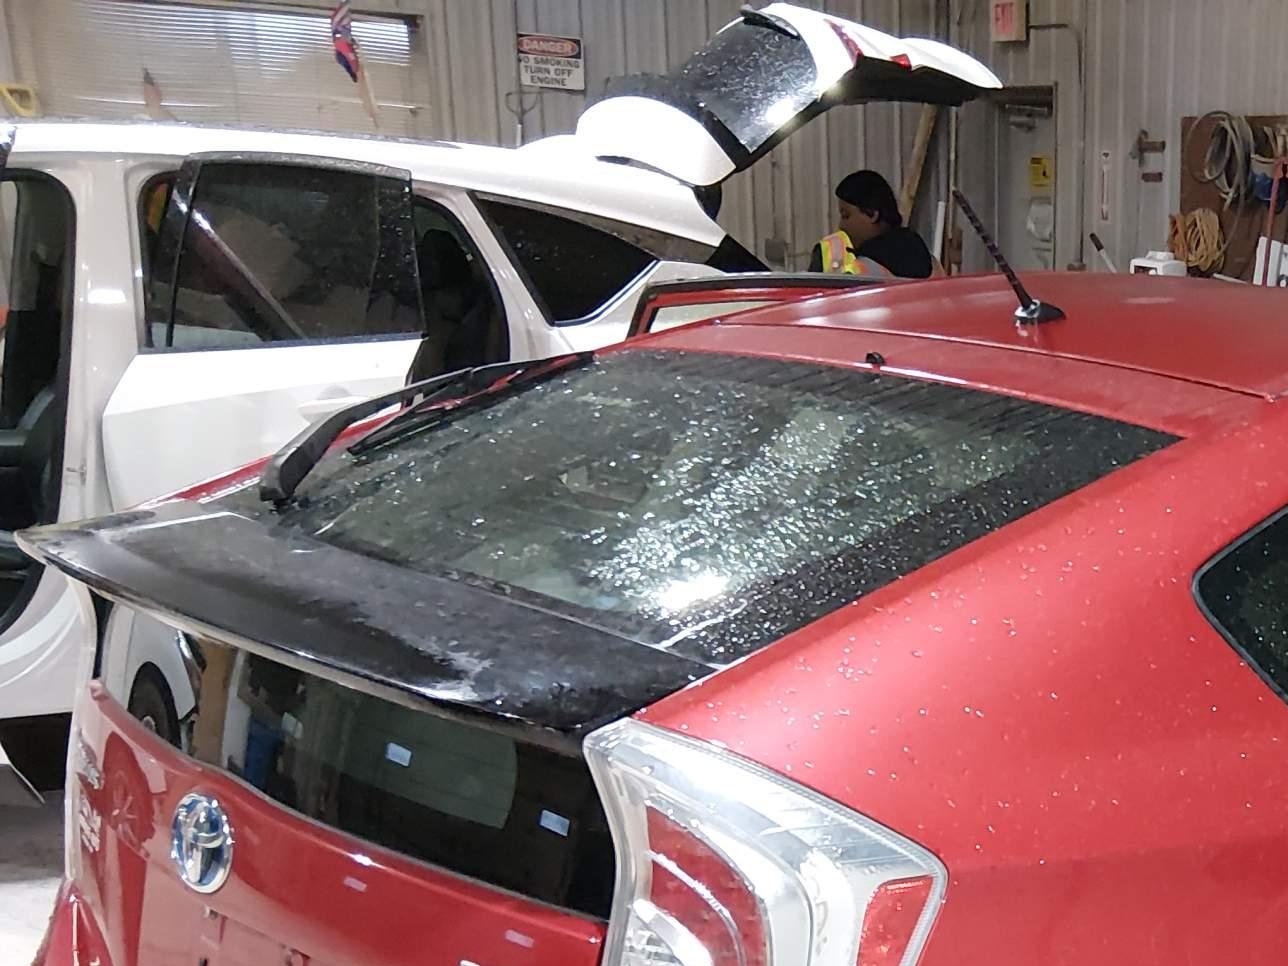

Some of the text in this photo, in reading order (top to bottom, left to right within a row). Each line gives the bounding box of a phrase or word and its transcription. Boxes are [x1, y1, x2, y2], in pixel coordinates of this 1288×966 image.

[522, 40, 573, 53] DANGER
[534, 57, 580, 68] SMOKING
[524, 65, 573, 77] TURN OFF
[530, 75, 567, 86] ENGINE
